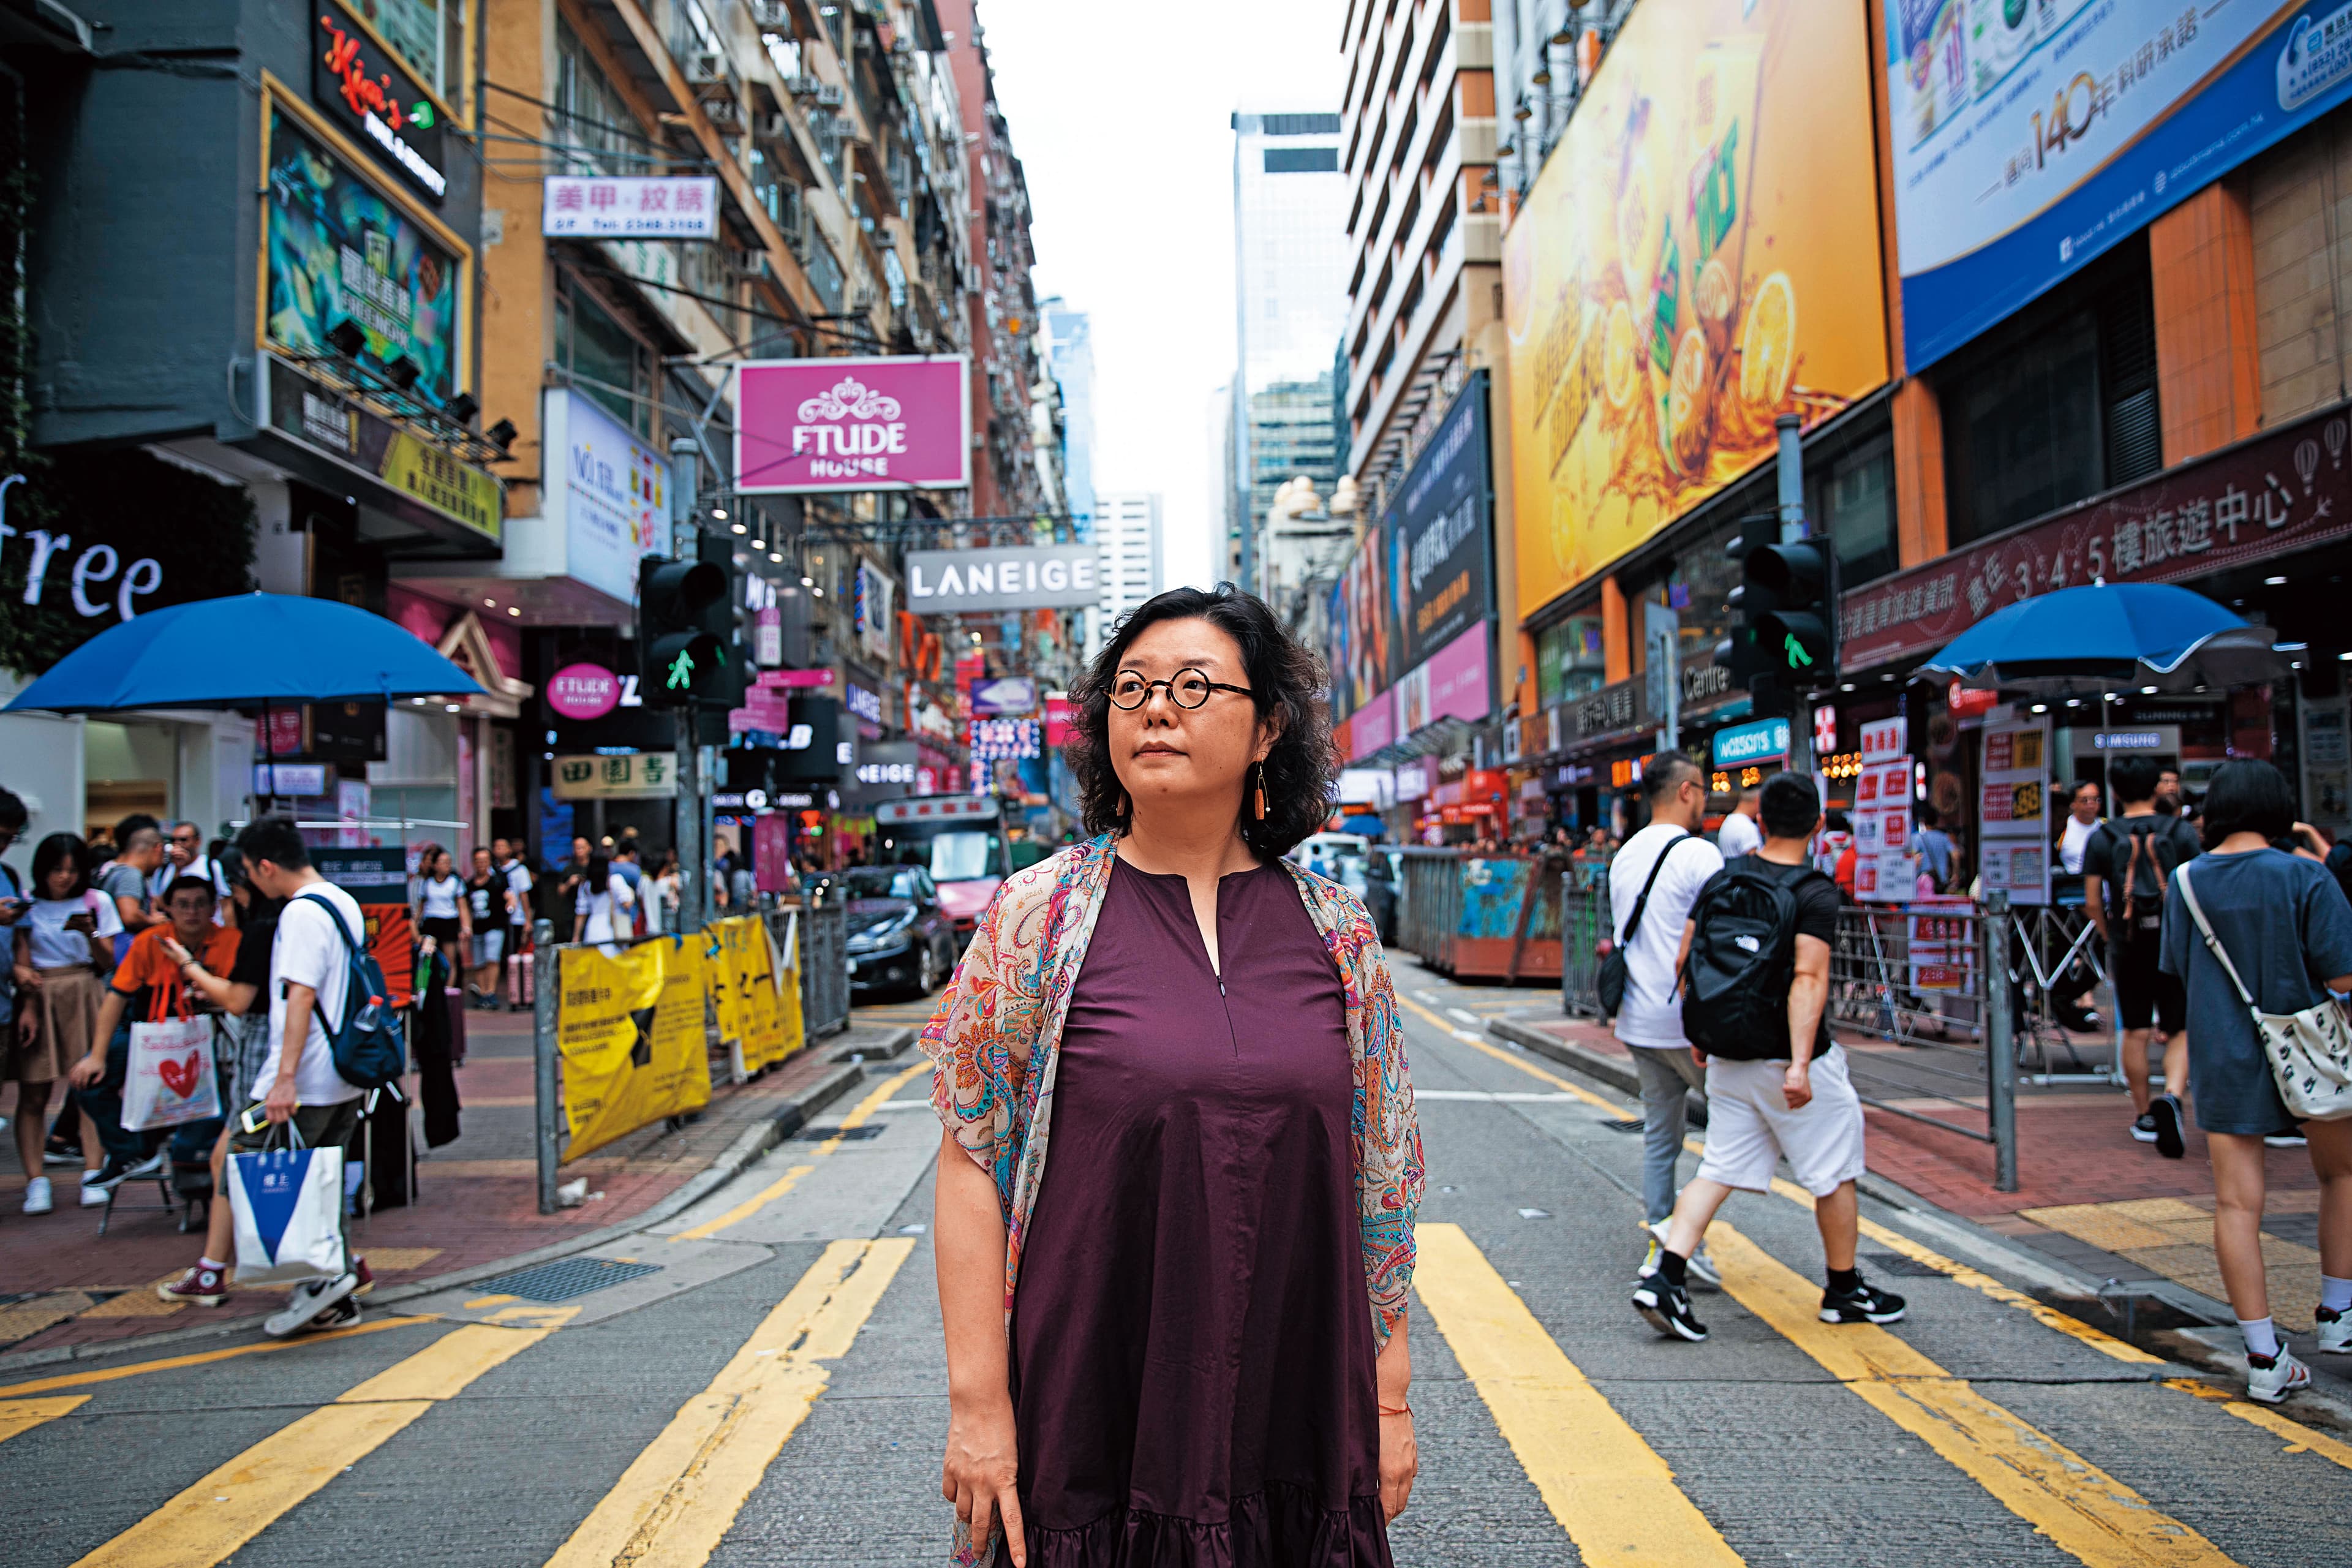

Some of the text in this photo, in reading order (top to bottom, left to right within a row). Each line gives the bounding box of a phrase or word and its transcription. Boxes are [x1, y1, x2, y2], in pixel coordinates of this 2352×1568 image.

[792, 422, 907, 456] ETUDE
[810, 457, 889, 478] HOUSE
[0, 473, 163, 622] free
[911, 558, 1095, 598] LANEIGE
[1684, 661, 1730, 701] Centre
[1719, 731, 1770, 758] watsons
